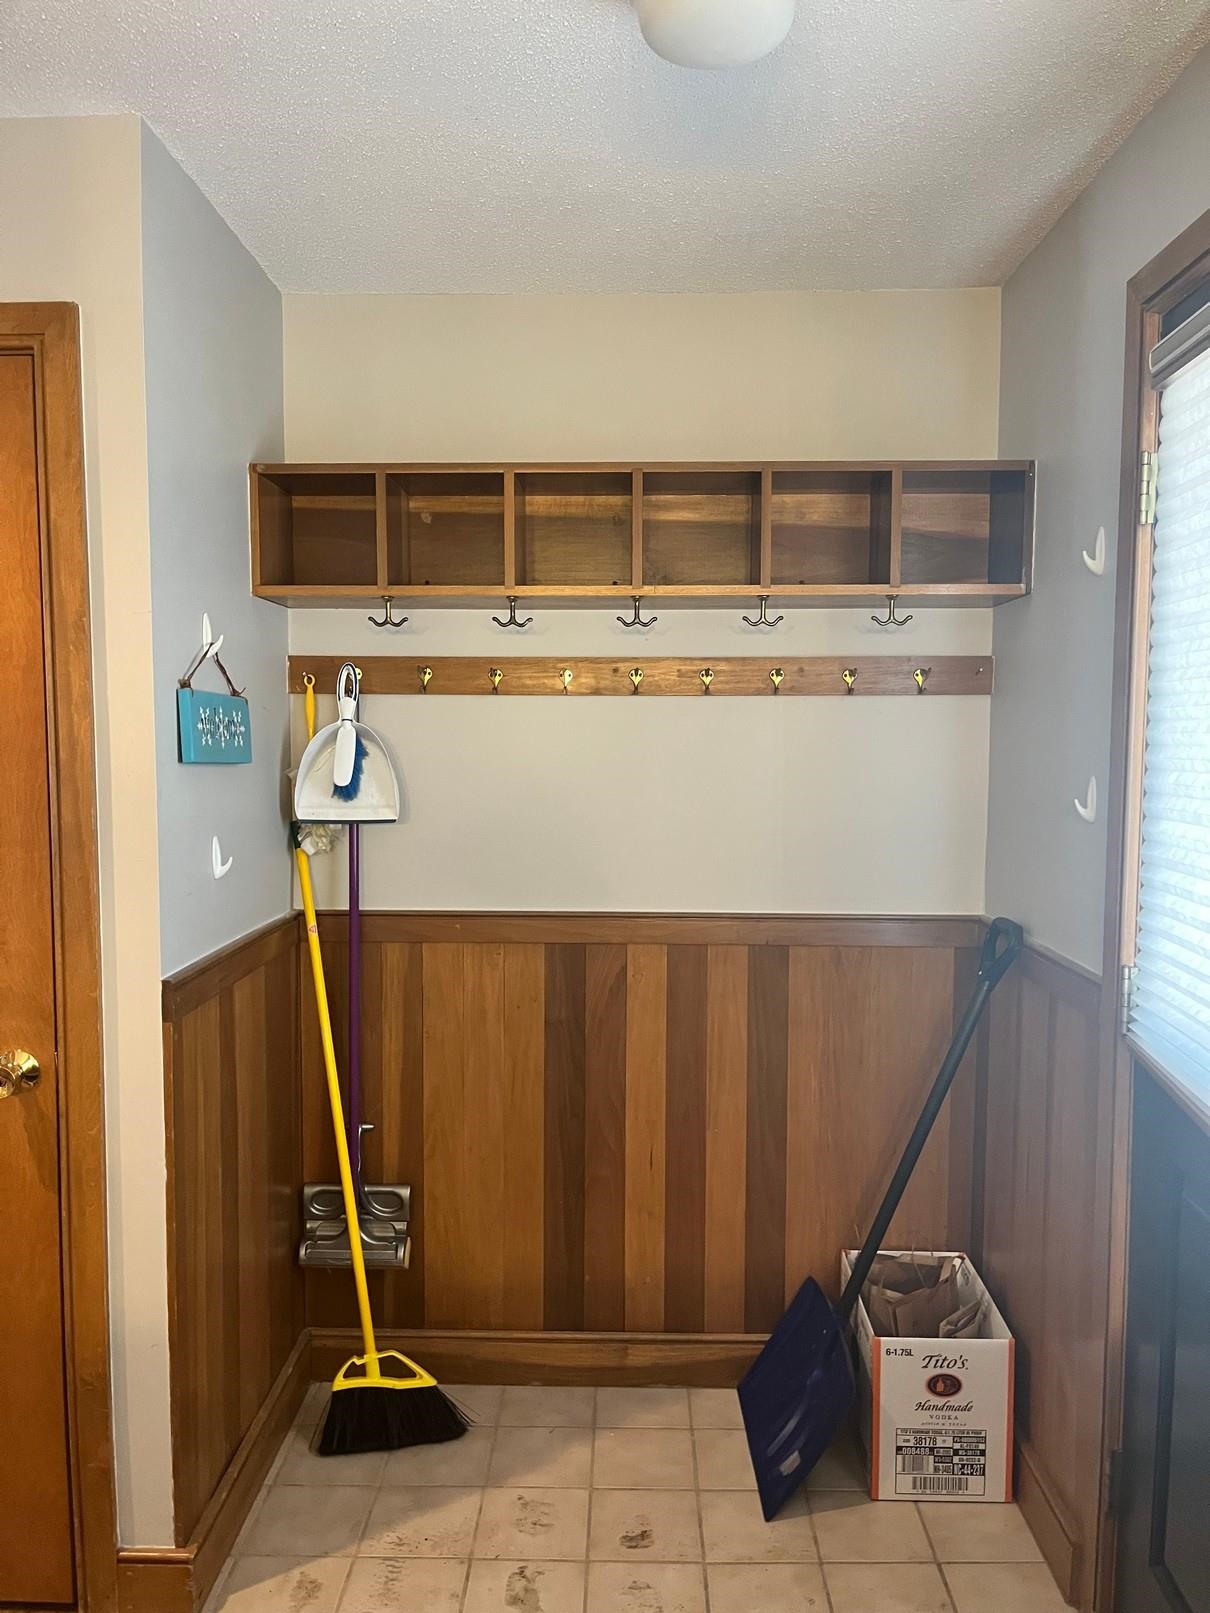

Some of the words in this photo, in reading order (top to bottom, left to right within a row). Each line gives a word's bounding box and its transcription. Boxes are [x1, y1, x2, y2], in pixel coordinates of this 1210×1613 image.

[885, 1348, 914, 1357] 6-1.75L
[921, 1353, 969, 1370] Tito's
[914, 1399, 974, 1412] Handmade
[913, 1436, 938, 1446] 38178
